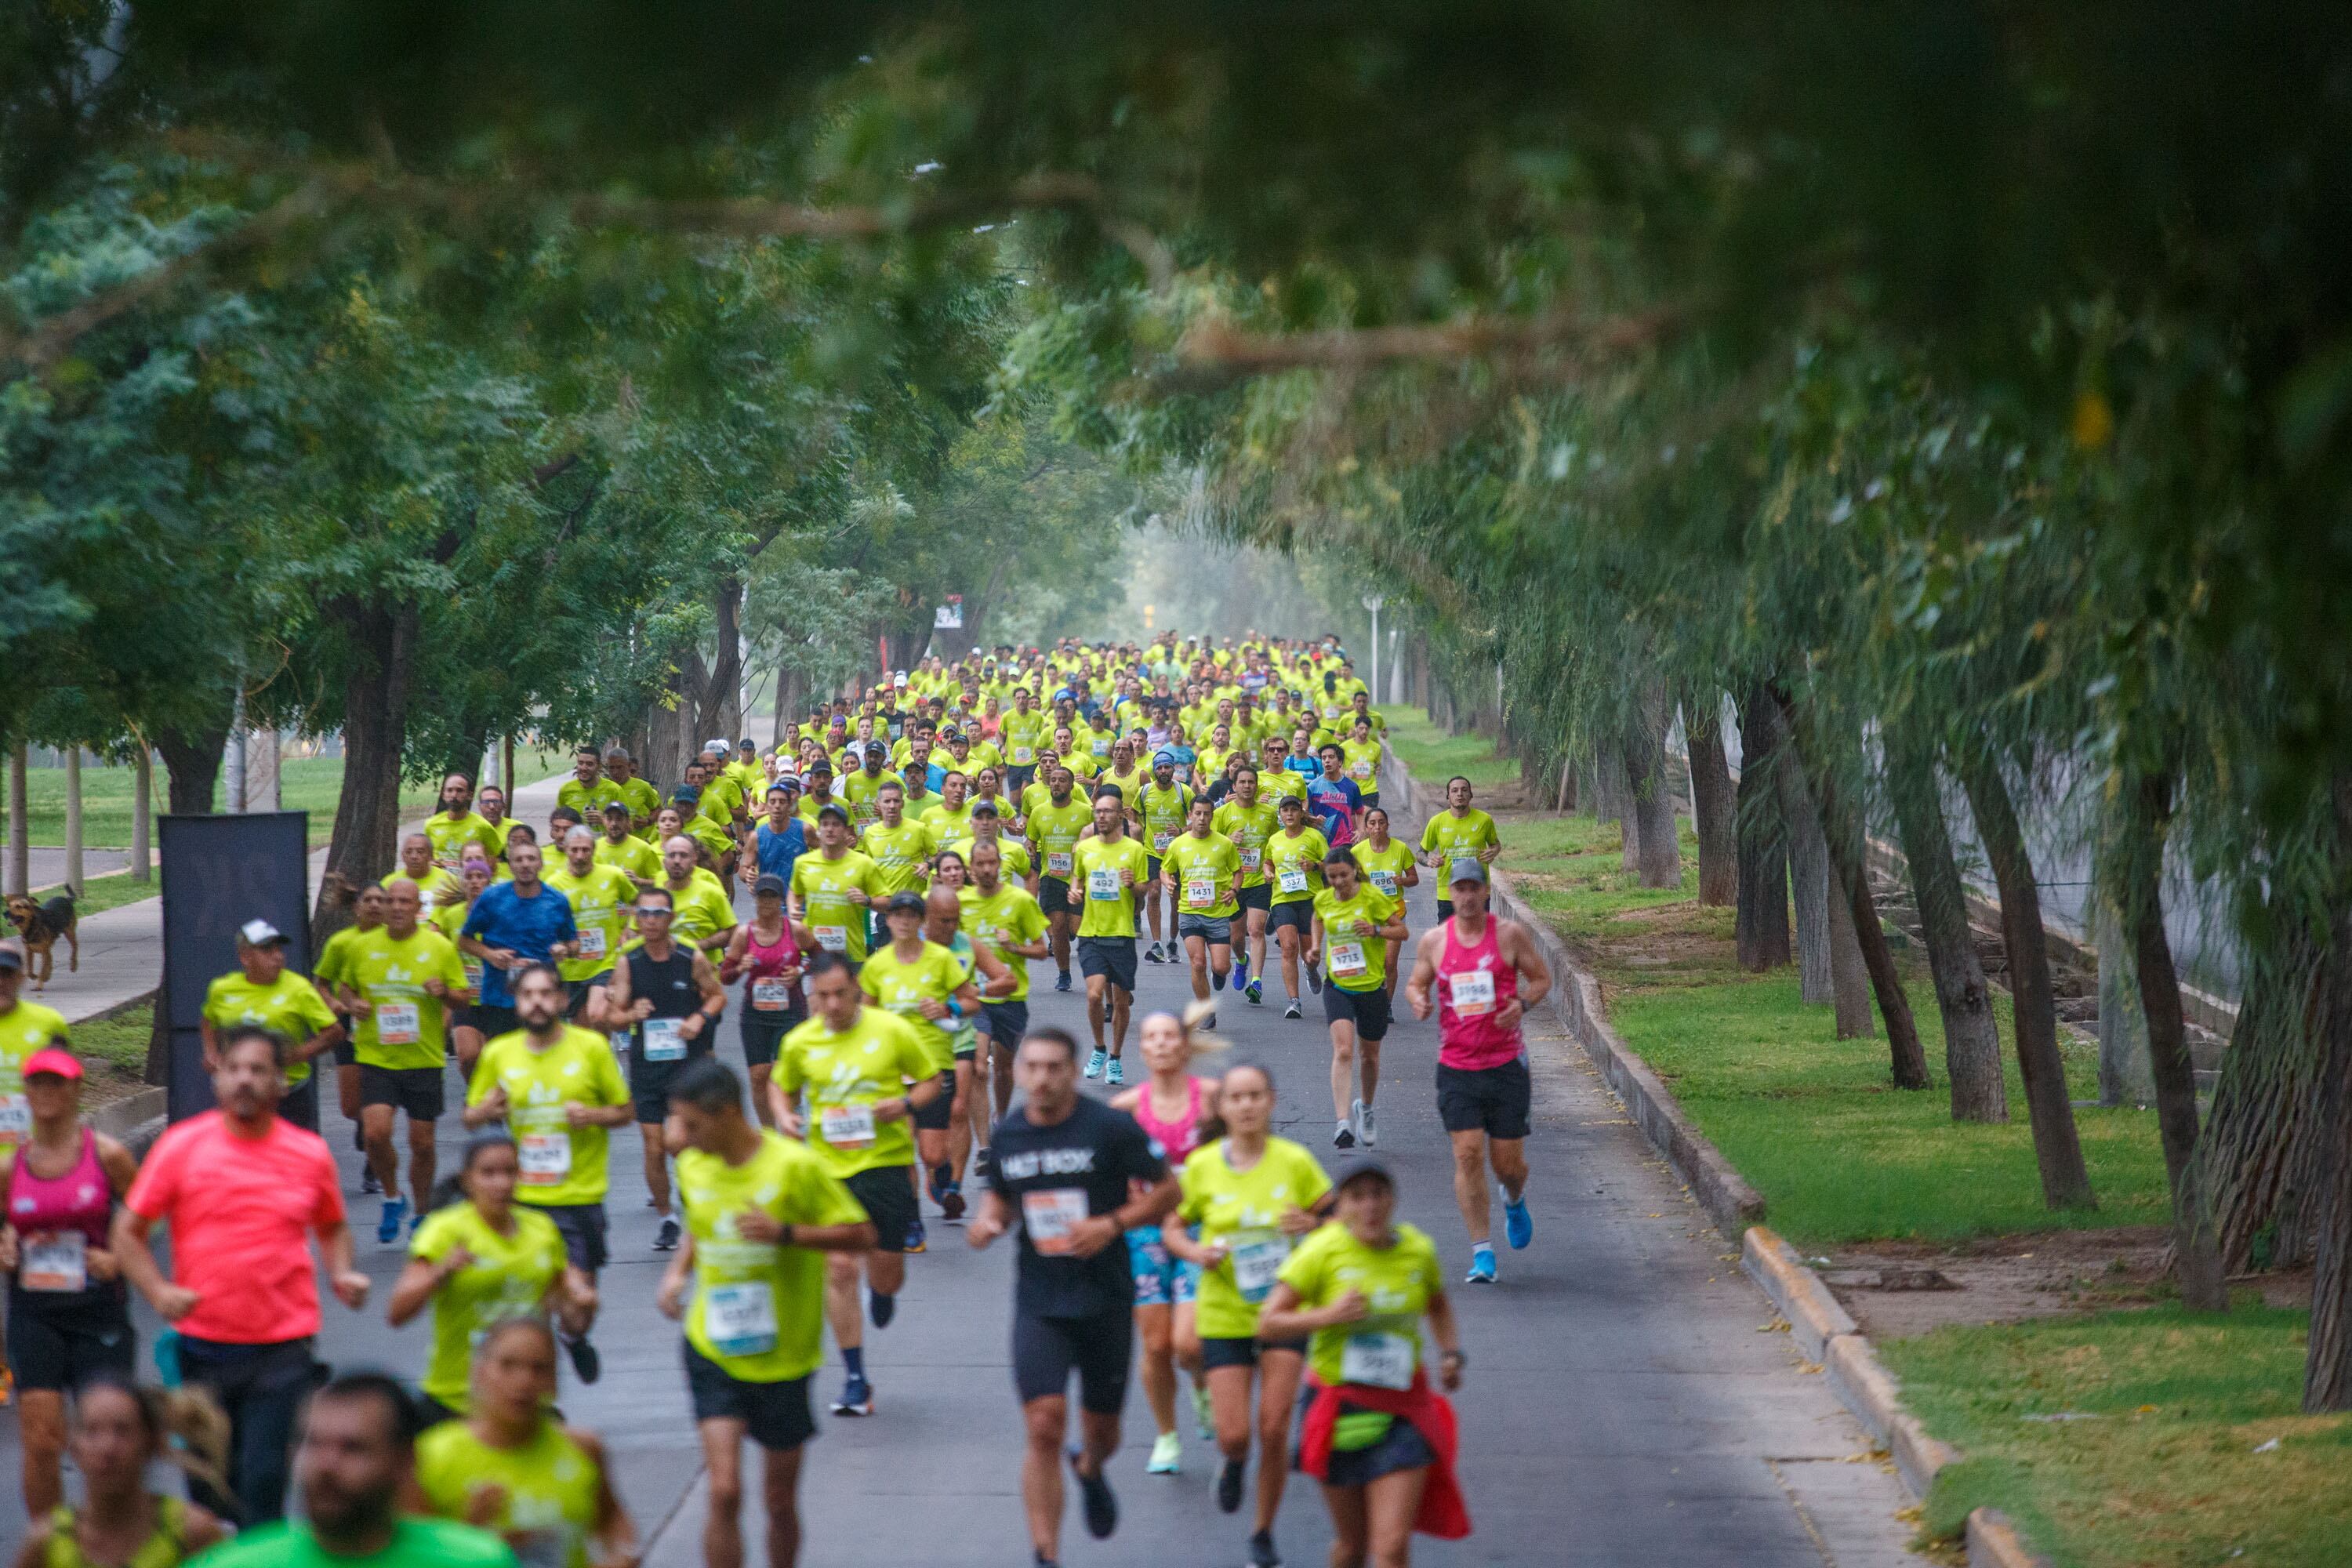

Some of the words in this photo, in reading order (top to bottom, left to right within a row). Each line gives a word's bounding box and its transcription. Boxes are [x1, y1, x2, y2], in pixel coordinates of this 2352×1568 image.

[1094, 879, 1113, 887] 492
[1286, 878, 1301, 887] 337
[1336, 953, 1359, 964] 1713
